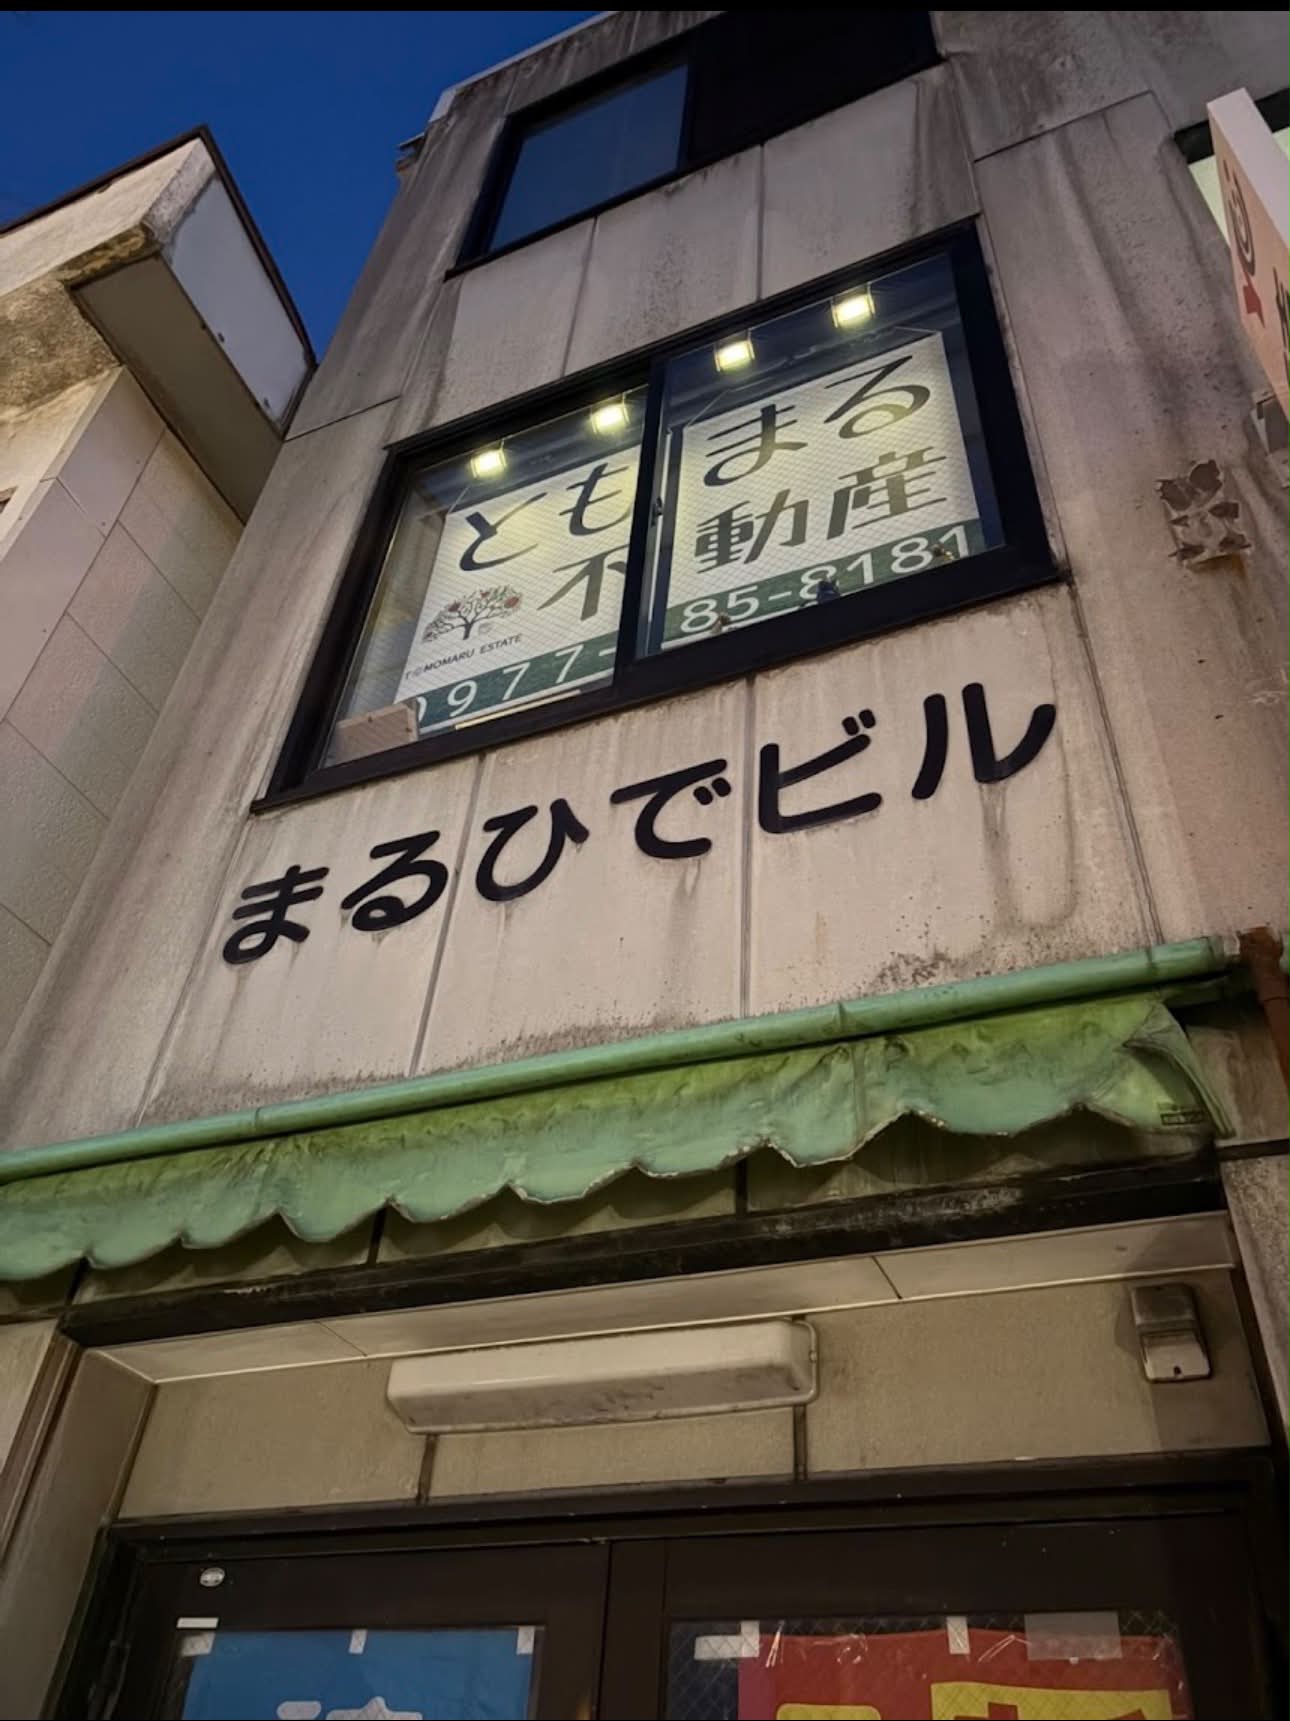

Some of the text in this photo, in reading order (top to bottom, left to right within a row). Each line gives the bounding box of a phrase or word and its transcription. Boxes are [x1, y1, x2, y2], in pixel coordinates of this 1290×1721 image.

[480, 633, 522, 655] ESTATE
[222, 682, 1057, 965] まるひでビル
